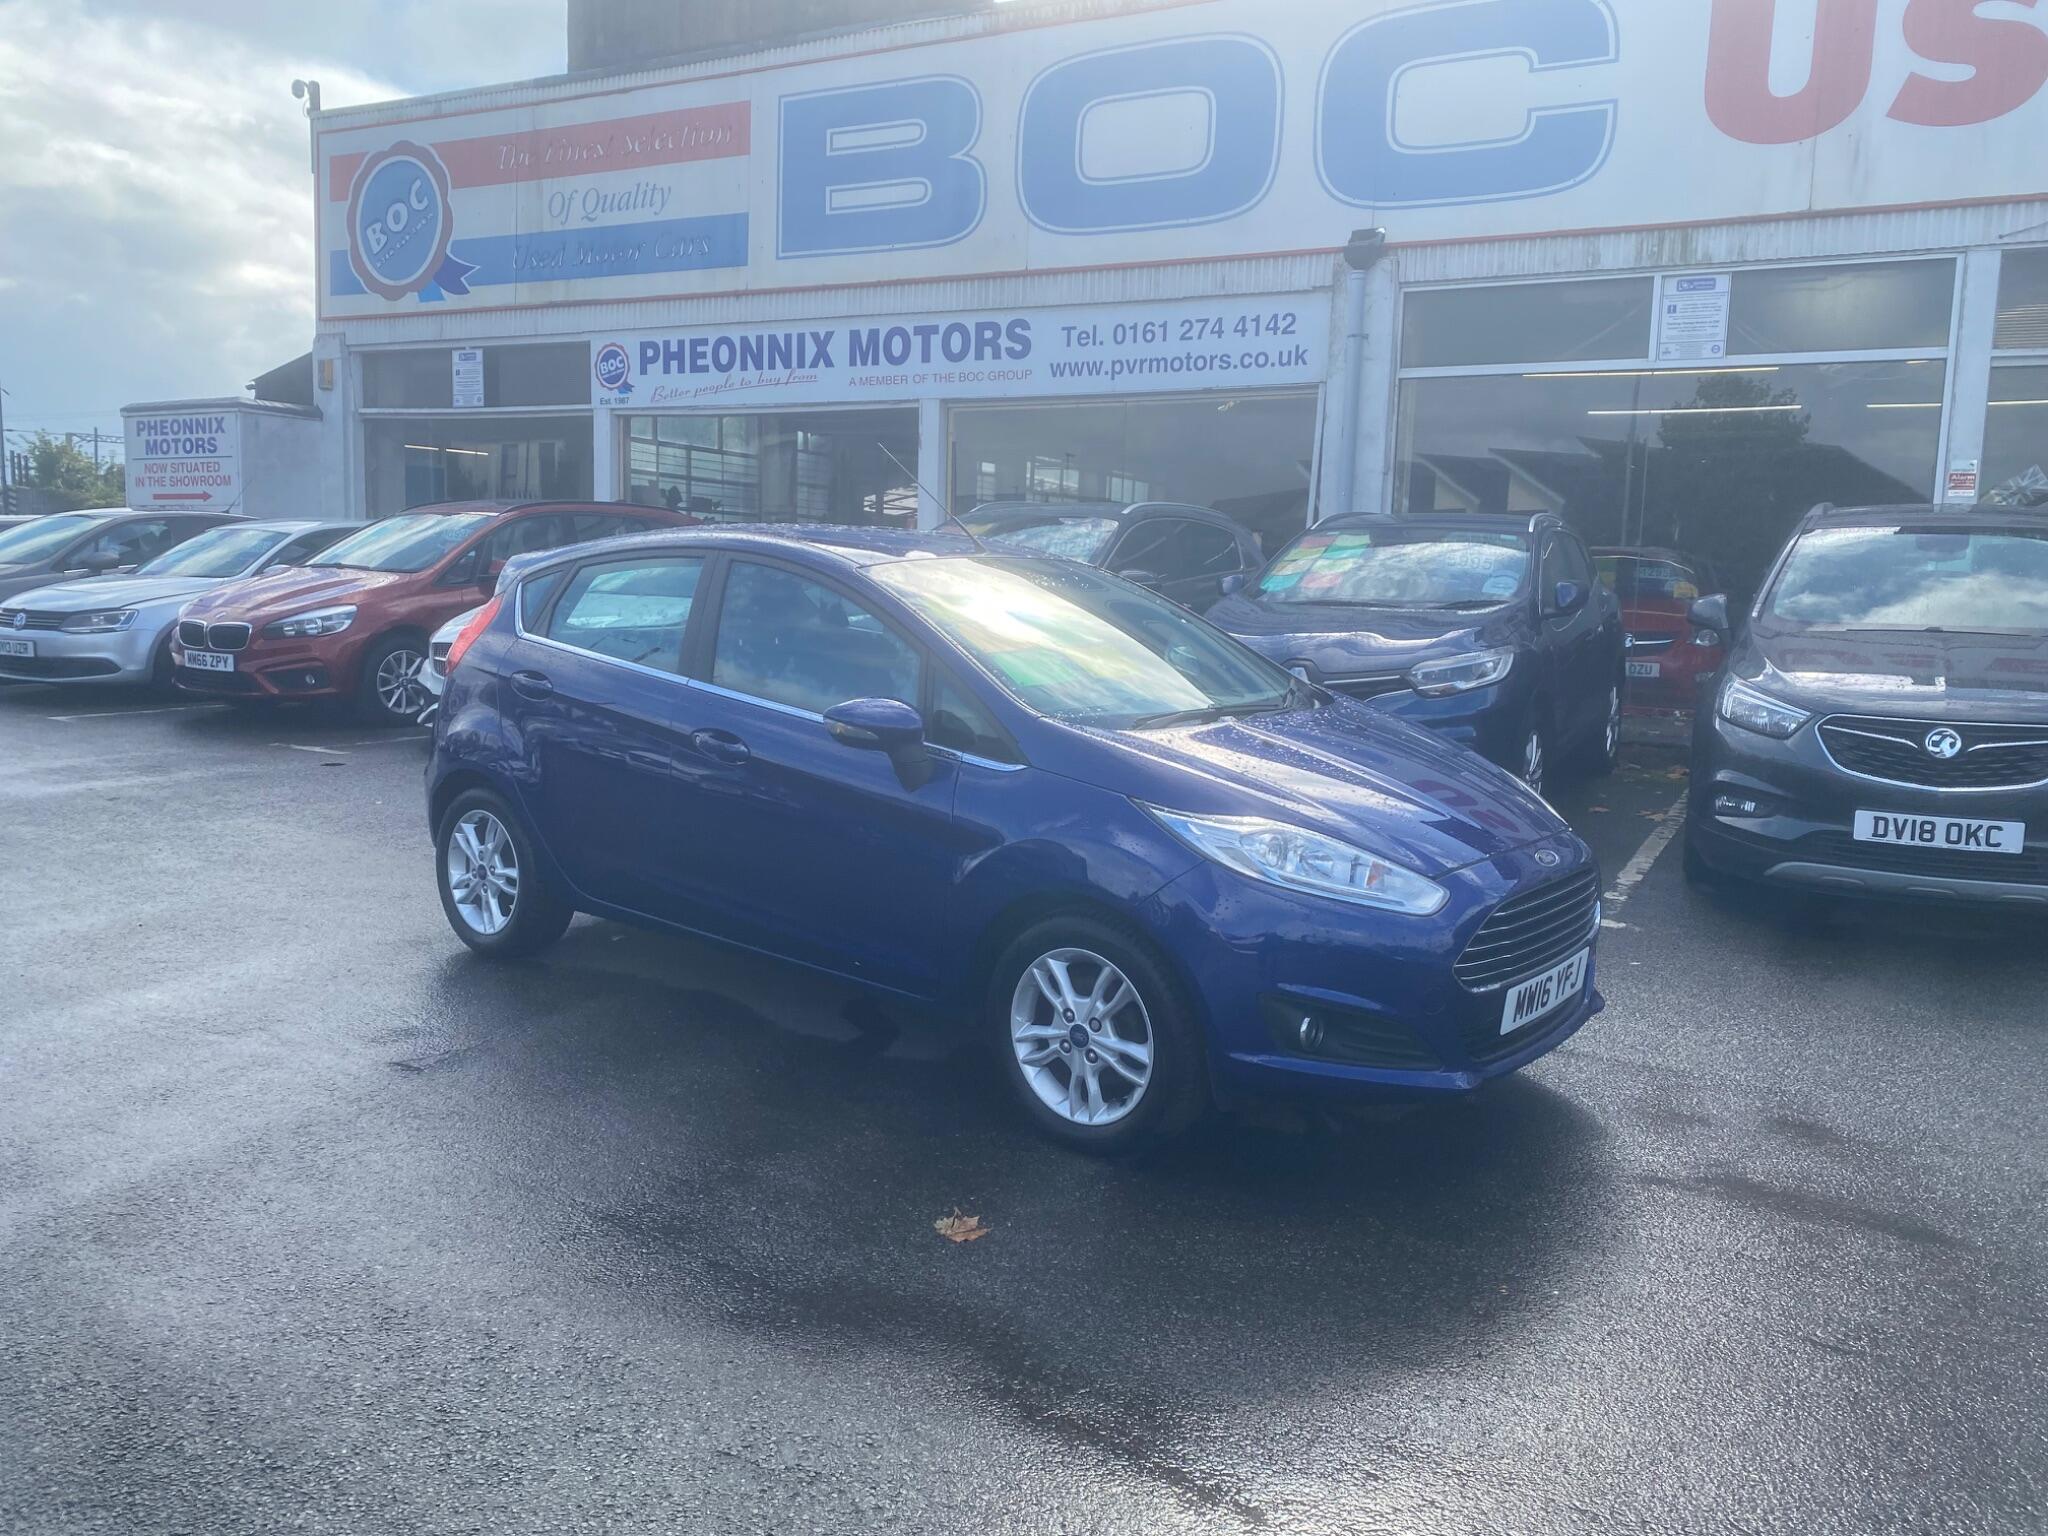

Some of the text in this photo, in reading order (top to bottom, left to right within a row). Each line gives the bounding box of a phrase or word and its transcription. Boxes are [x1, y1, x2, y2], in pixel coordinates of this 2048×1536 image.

[499, 121, 733, 169] The Finest Selection
[776, 0, 1620, 260] BOC
[366, 179, 429, 254] BOC
[549, 181, 671, 225] Of Quality
[512, 233, 711, 272] Used Motor Cars
[639, 318, 1032, 376] PHEONNIX MOTORS
[1060, 312, 1297, 347] Tel. 0161 274 4142
[600, 356, 624, 374] BOC
[849, 369, 1033, 387] A MEMBER OF THE BOC GROUP
[1050, 345, 1309, 381] www.pvrmotors.co.uk
[650, 368, 817, 403] Better people to buy from
[136, 416, 226, 437] PHEONNIX
[145, 437, 218, 456] MOTORS
[135, 474, 232, 487] IN THE SHOWROOM
[144, 461, 221, 475] NOW SITUATED
[209, 655, 229, 669] ZPY
[1871, 815, 2004, 848] DV18 OKC
[1512, 955, 1583, 1023] MW16 YFJ
